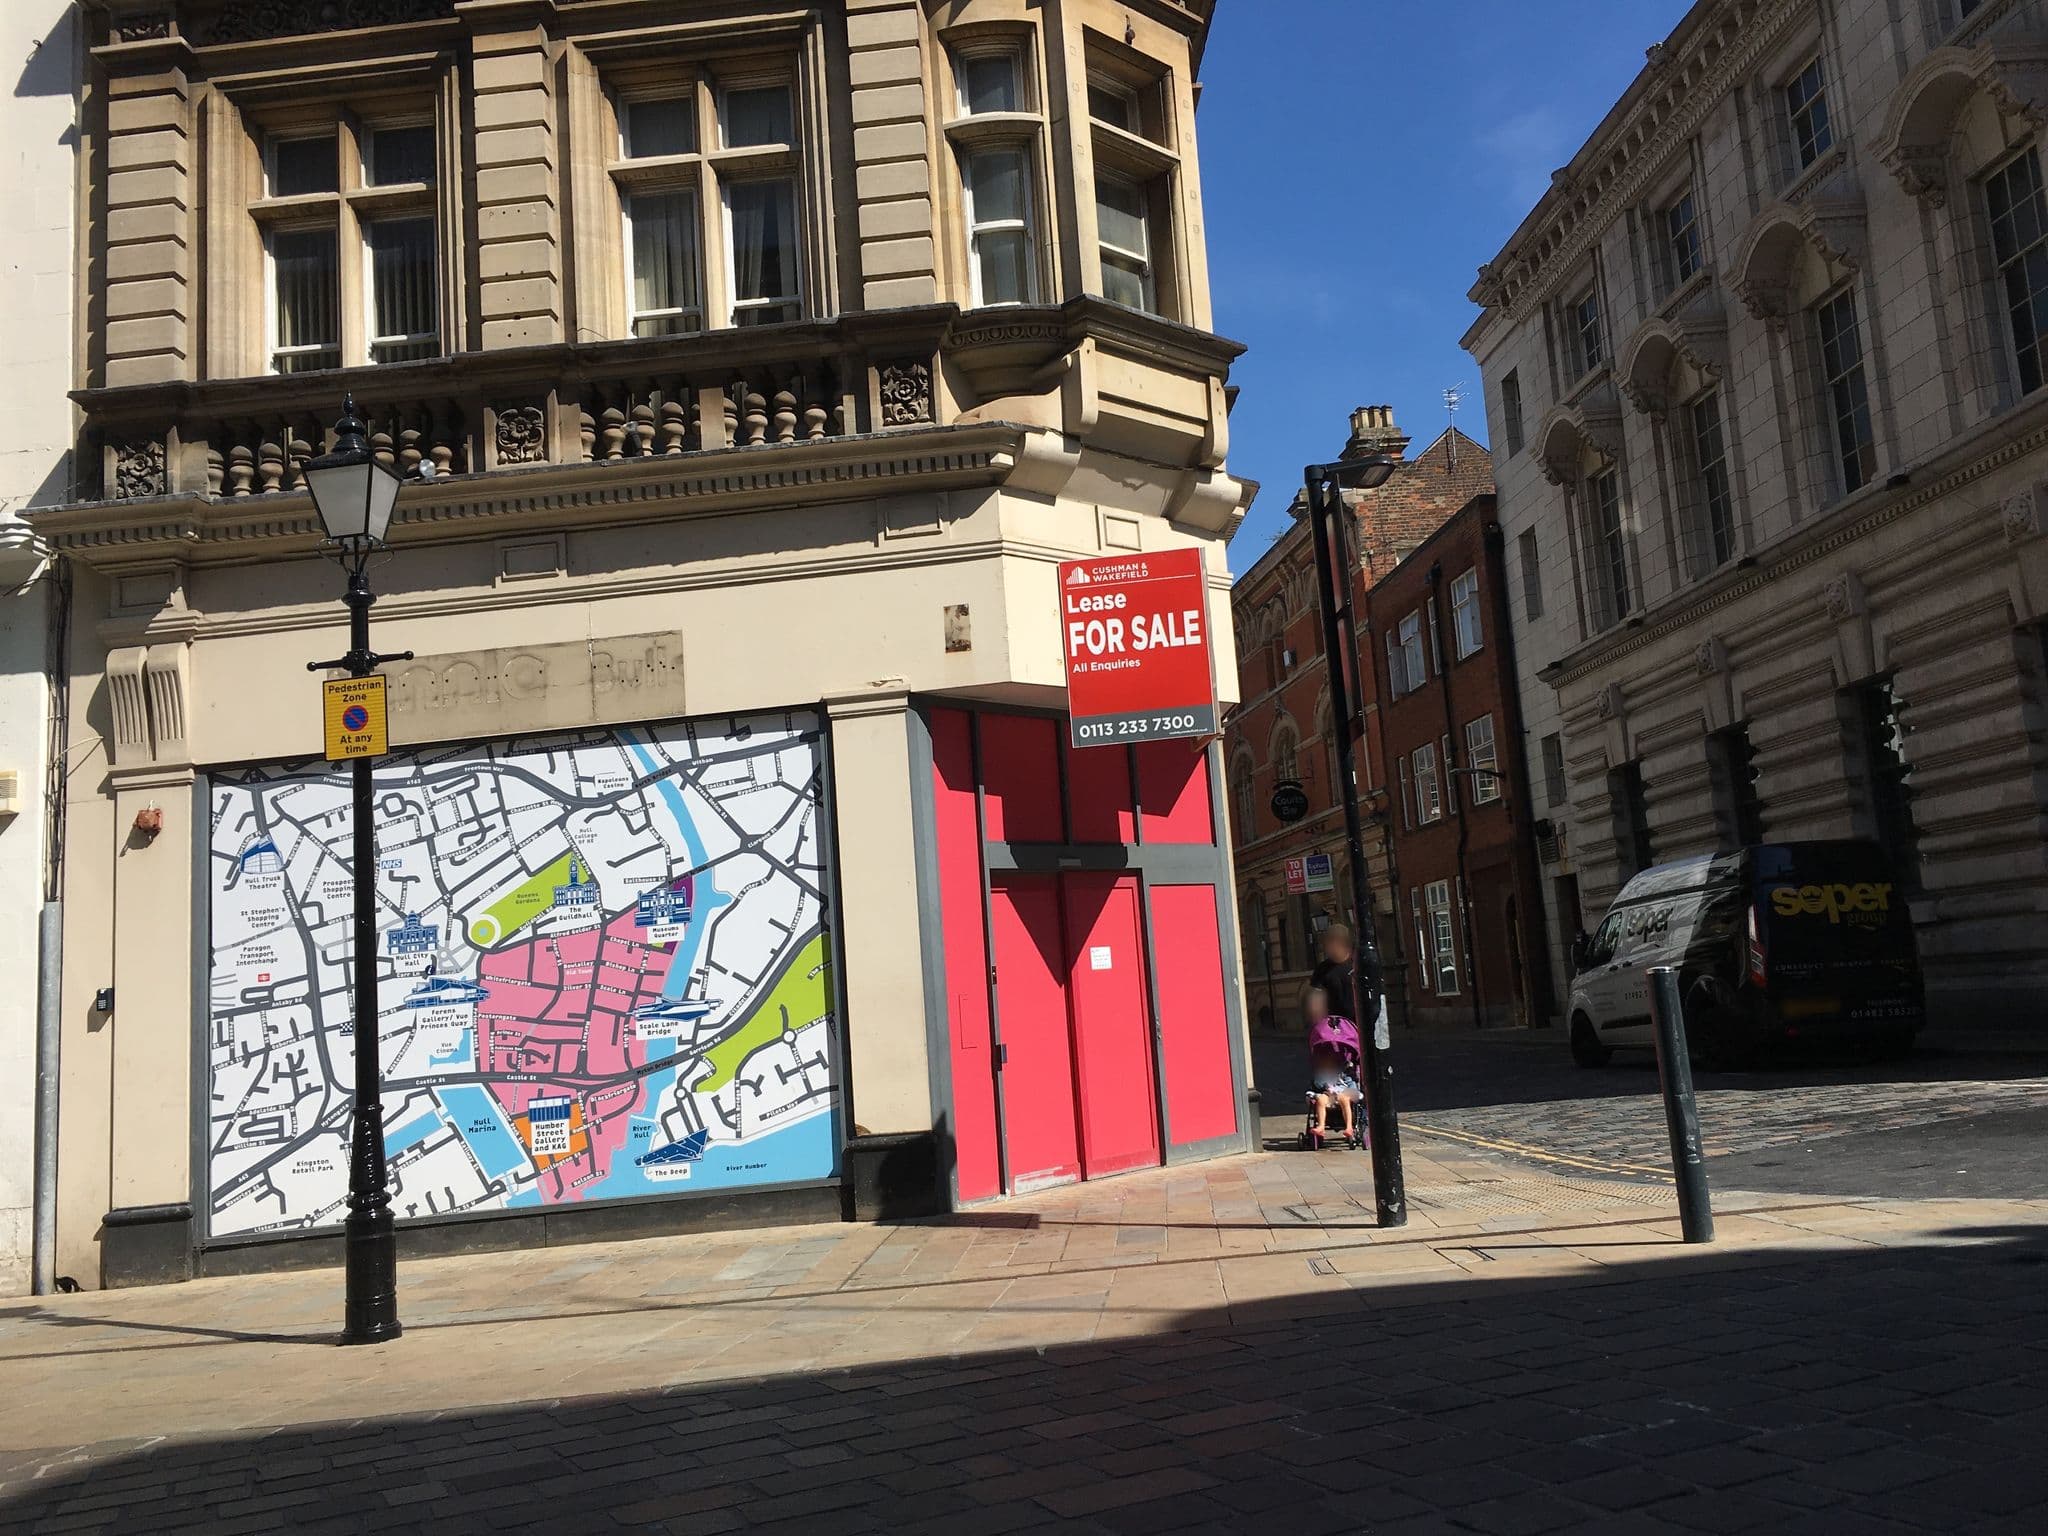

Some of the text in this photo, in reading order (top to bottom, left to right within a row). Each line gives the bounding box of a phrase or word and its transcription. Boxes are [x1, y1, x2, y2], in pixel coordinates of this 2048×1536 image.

[1092, 562, 1147, 574] CUSHMAN &
[1092, 570, 1149, 583] WAKEFIELD
[1066, 592, 1127, 614] Lease
[1069, 610, 1201, 657] FOR SALE
[1072, 658, 1141, 673] All Enquiries
[328, 681, 382, 694] Pedestrian
[342, 693, 368, 703] Zone
[1079, 723, 1114, 738] 0113
[1118, 719, 1148, 734] 233
[1152, 714, 1195, 732] 7300
[340, 734, 373, 744] At any
[345, 745, 368, 754] time
[323, 777, 350, 785] Freetown
[381, 860, 402, 869] NHS
[1289, 860, 1300, 869] TO
[1288, 870, 1302, 879] LET
[249, 882, 277, 890] Theatre
[251, 907, 286, 916] Stephen's
[247, 914, 279, 923] Shopping
[559, 912, 593, 921] Guildhall
[551, 930, 570, 938] Alfred
[610, 937, 630, 946] Chapel
[240, 951, 274, 959] Transport
[236, 957, 278, 967] Interchange
[605, 961, 627, 970] Bishop
[485, 975, 531, 986] Whitefriargate
[600, 985, 617, 993] Scale
[272, 1000, 293, 1008] Anlaby
[478, 1013, 517, 1021] Posterngate
[647, 1029, 671, 1037] Bridge
[468, 1125, 497, 1133] Marina
[535, 1122, 565, 1130] Humber
[536, 1129, 563, 1137] Street
[535, 1136, 566, 1146] Gallery
[296, 1159, 329, 1167] Kingston
[670, 1168, 688, 1176] Deep
